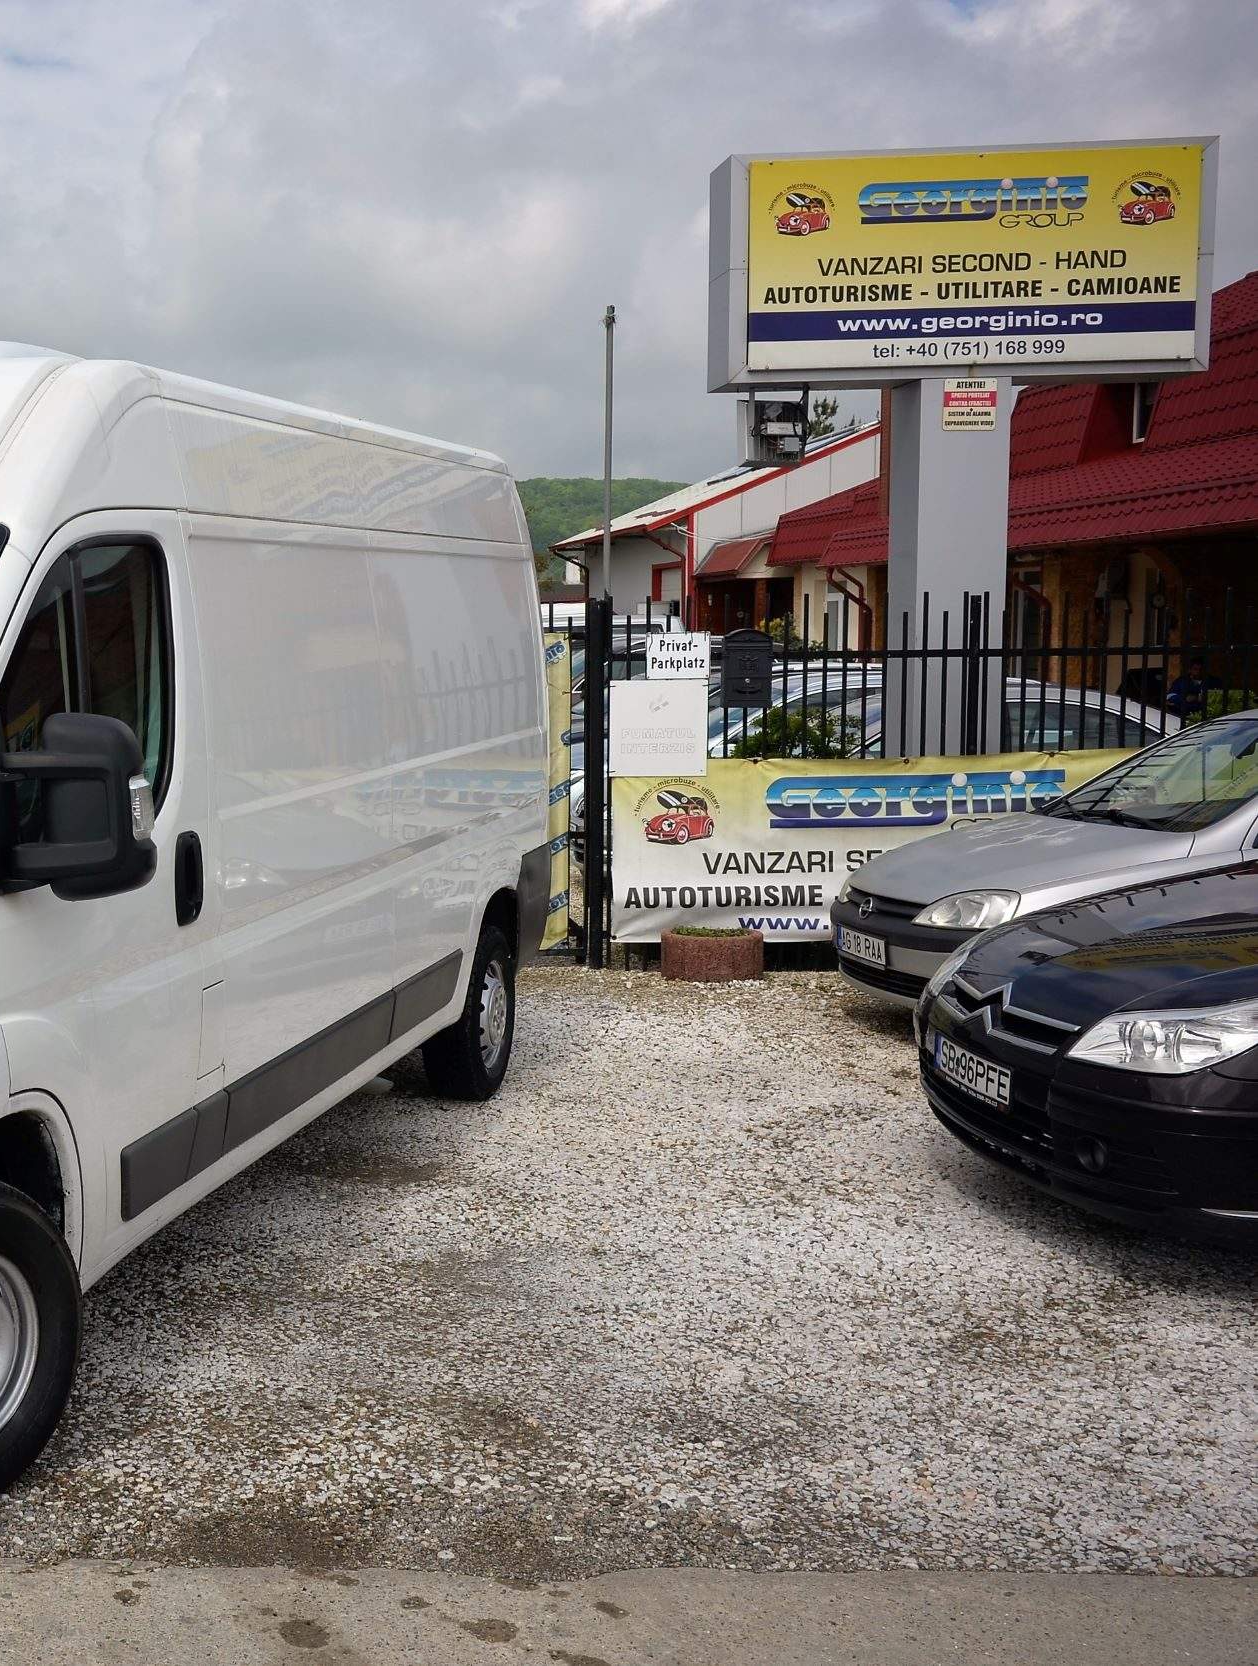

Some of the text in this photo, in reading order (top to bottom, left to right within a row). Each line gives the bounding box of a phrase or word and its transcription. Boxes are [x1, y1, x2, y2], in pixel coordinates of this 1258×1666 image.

[858, 175, 1089, 224] Georginio
[999, 212, 1085, 229] GROUP
[817, 256, 923, 277] VANZARI
[931, 252, 1032, 274] SECOND
[1055, 249, 1127, 270] HAND
[763, 283, 913, 305] AUTOTURISME
[936, 279, 1042, 300] UTILITARE
[1067, 275, 1181, 296] CAMIOANE
[837, 310, 1104, 333] www.georginio.ro
[873, 339, 1065, 360] tel: +40 (751) 168 999
[659, 639, 699, 652] Privat-
[651, 656, 706, 672] Parkplatz
[621, 728, 696, 739] FUMATUL
[620, 742, 696, 754] INTERZIS
[657, 776, 696, 787] microbuze
[702, 851, 834, 875] VANZARI
[624, 885, 824, 909] AUTOTURISME
[864, 938, 883, 961] RAA
